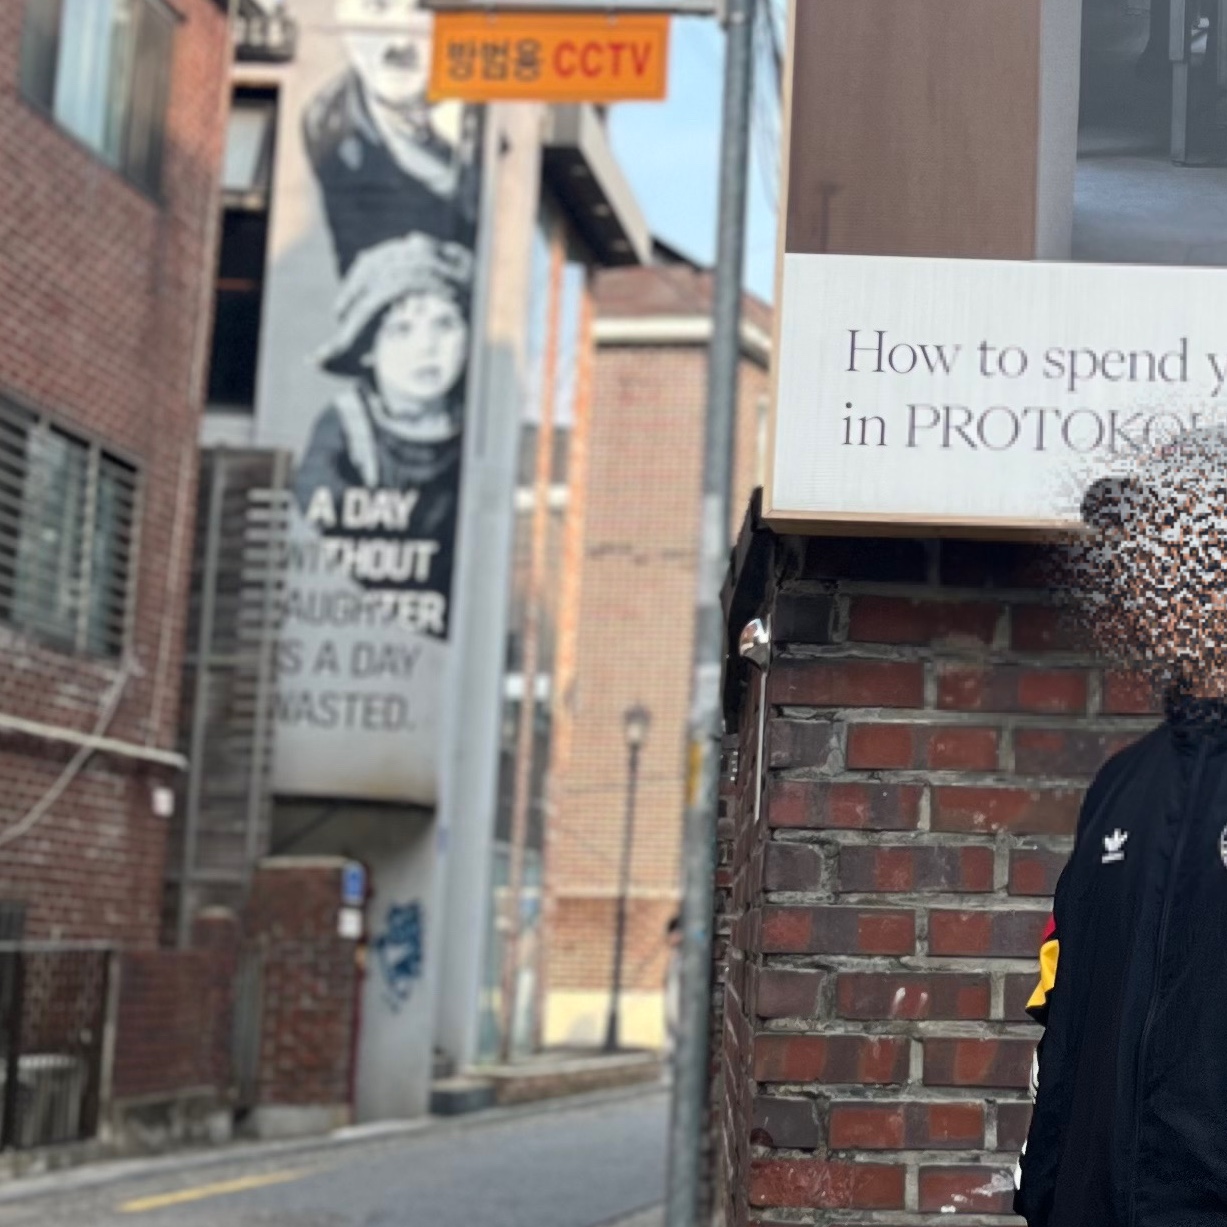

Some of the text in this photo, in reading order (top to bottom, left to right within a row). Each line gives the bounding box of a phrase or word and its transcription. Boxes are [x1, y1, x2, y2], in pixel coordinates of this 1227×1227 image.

[552, 40, 651, 79] CCTV
[844, 328, 961, 376] How
[977, 339, 1029, 379] to
[1042, 336, 1189, 393] spend
[841, 400, 1206, 454] in PROTOKO
[304, 486, 419, 531] A DAY
[282, 588, 447, 635] AUGHTER
[311, 639, 341, 677] A
[350, 641, 421, 681] DAY
